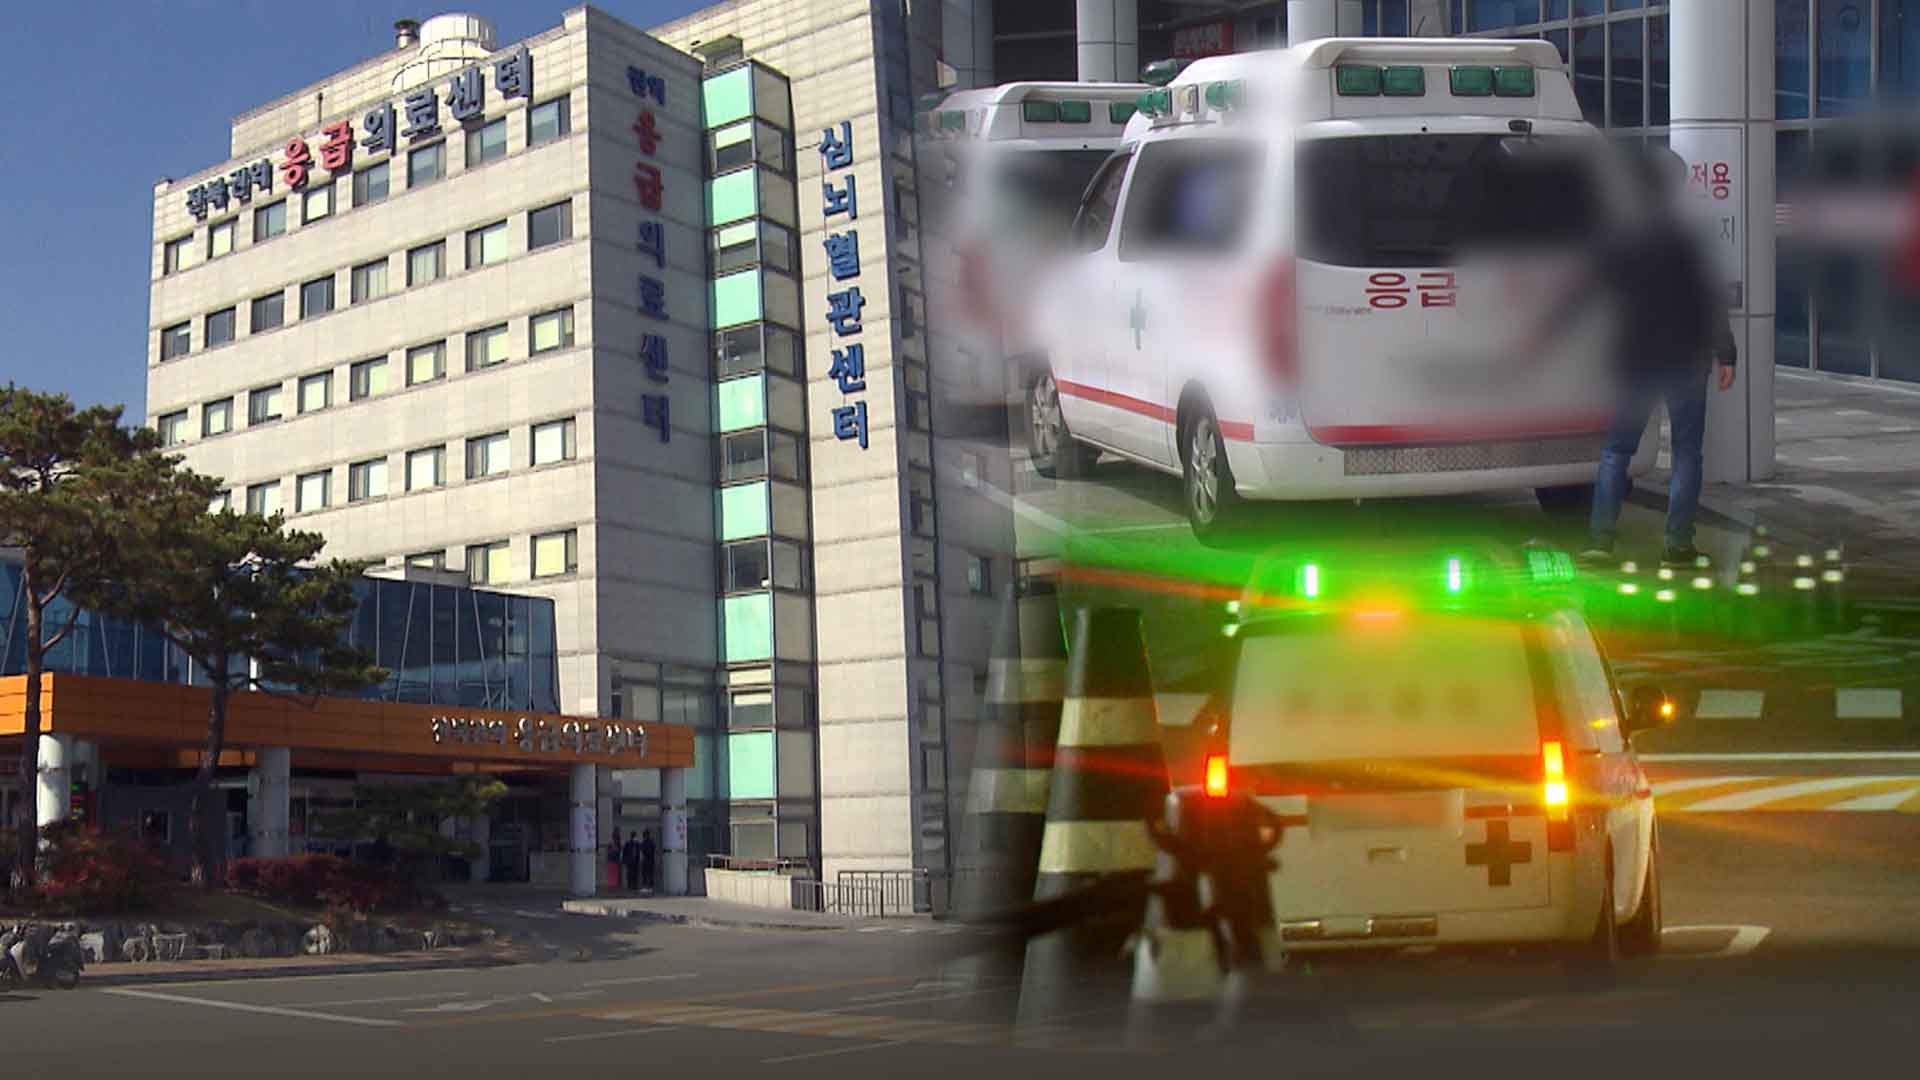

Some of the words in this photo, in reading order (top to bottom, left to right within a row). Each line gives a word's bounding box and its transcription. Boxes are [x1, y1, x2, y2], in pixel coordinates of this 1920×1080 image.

[279, 45, 533, 192] 응급의료센터
[632, 111, 671, 443] 응급의료센터
[819, 120, 869, 450] 심뇌혈관센터
[1365, 272, 1457, 308] 응급
